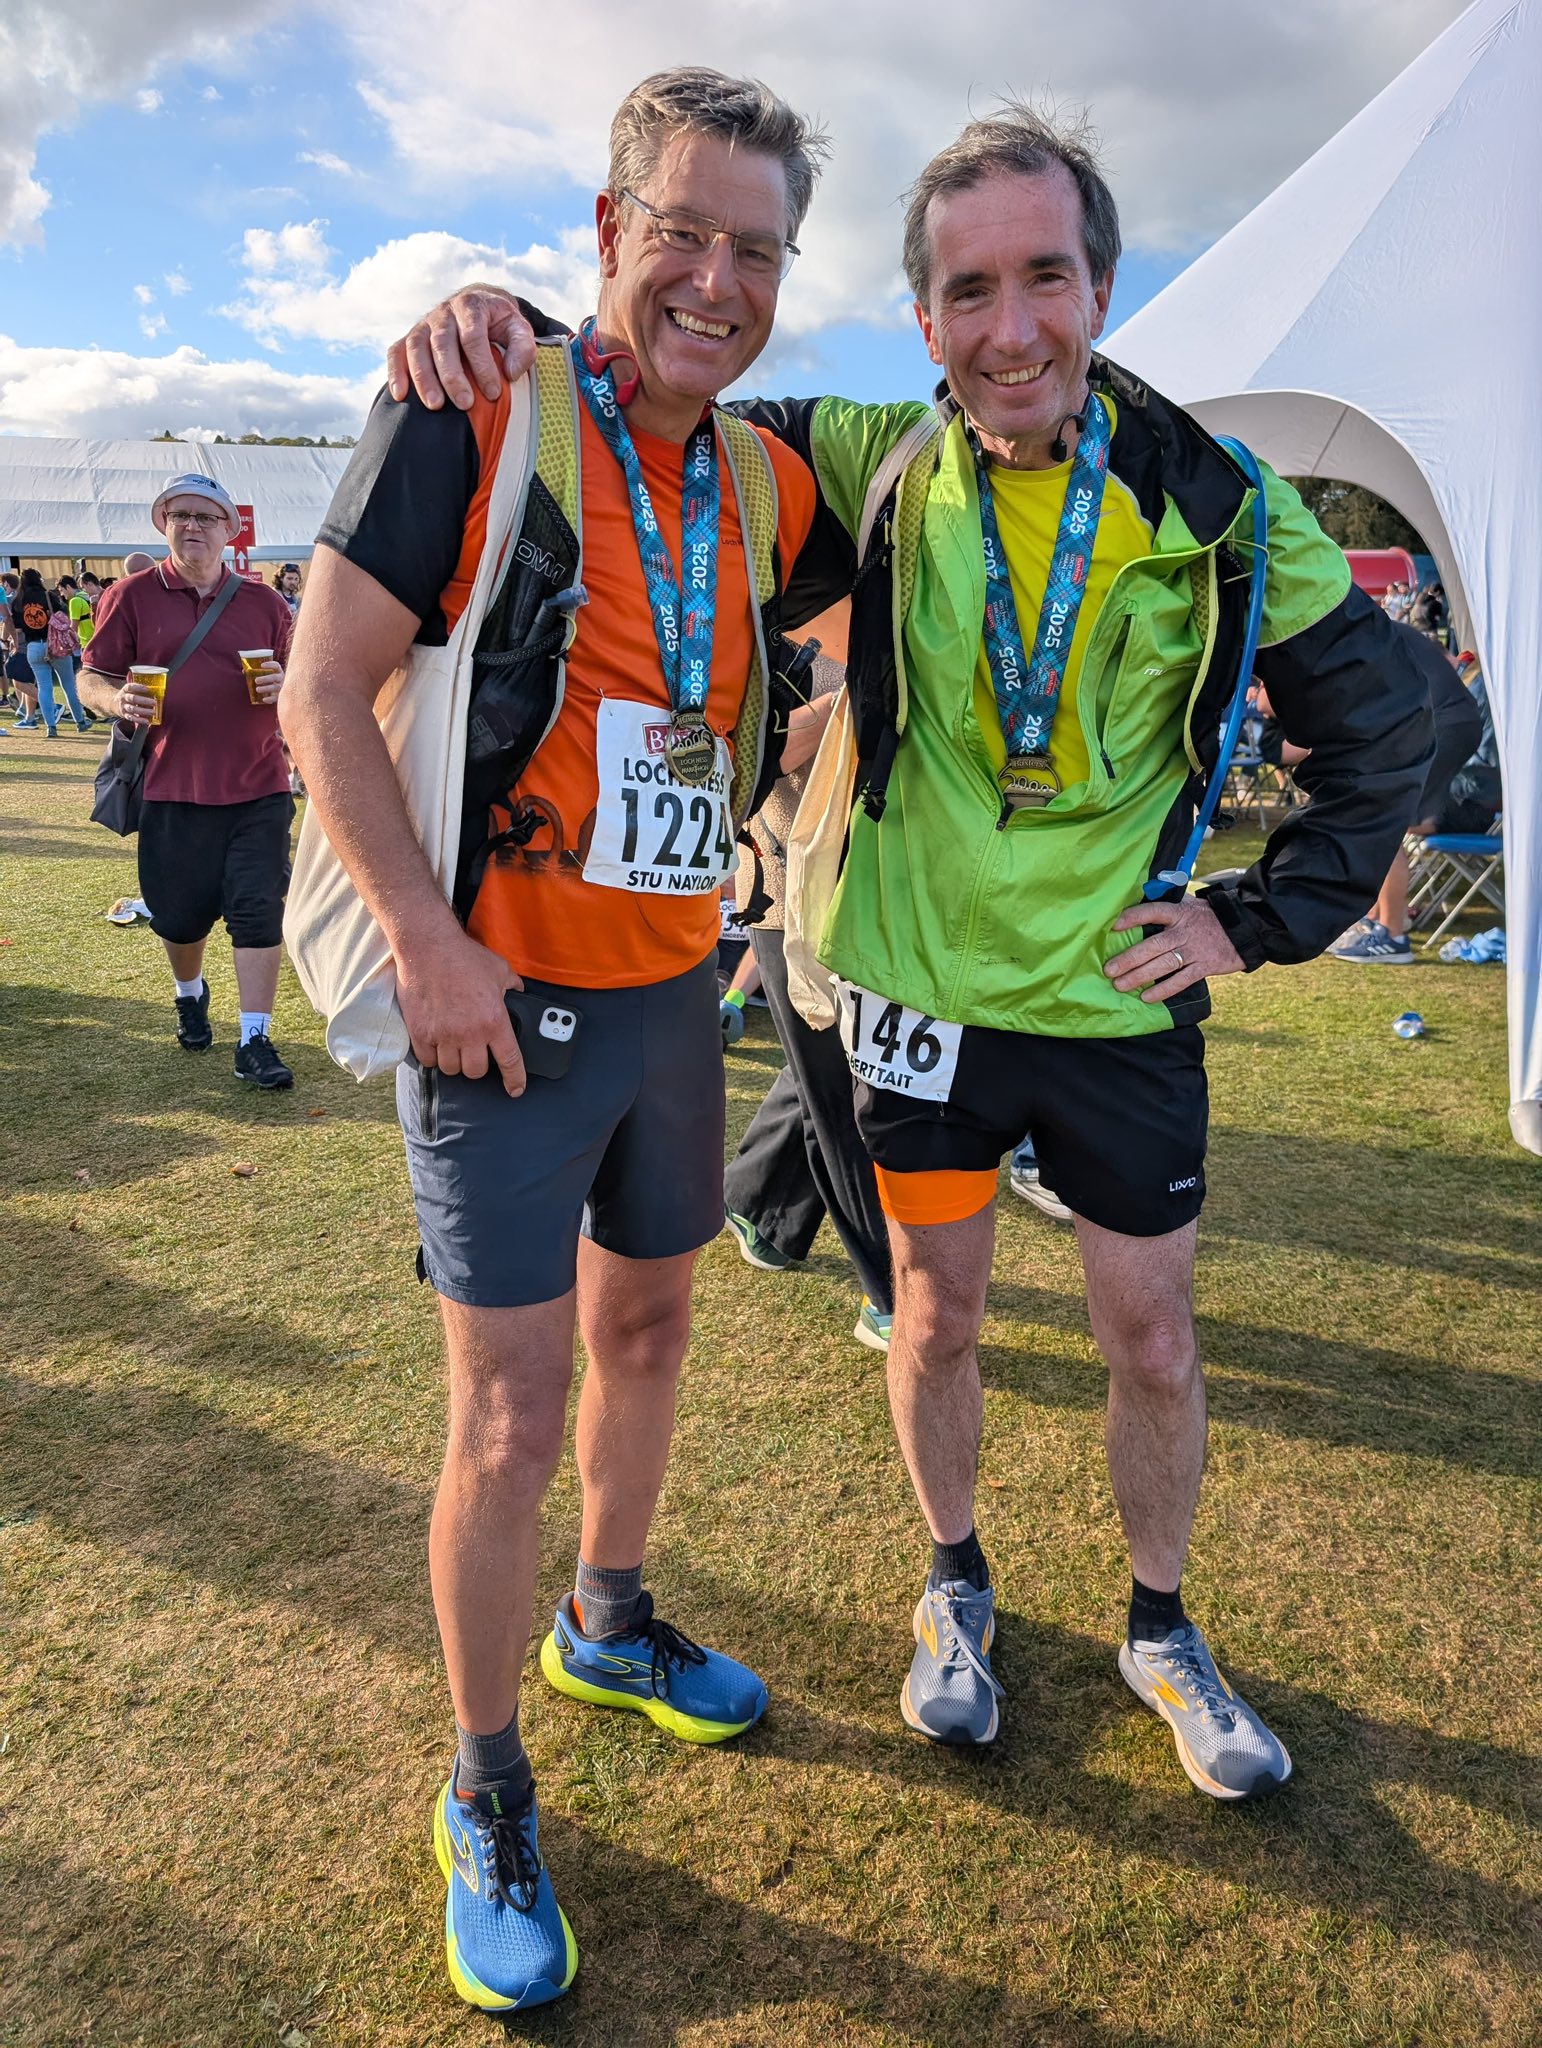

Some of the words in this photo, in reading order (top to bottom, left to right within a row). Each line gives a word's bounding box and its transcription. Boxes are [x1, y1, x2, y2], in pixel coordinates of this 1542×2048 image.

[590, 375, 616, 418] 2025
[695, 434, 711, 478] 2025
[638, 482, 657, 532] 2025
[1069, 487, 1092, 535] 2025
[691, 542, 708, 589] 2025
[660, 604, 680, 652] 2025
[1044, 601, 1068, 648] 2025
[690, 659, 704, 706] 2025
[999, 646, 1021, 692] 2025
[621, 788, 733, 870] 1224
[627, 871, 663, 888] STU
[668, 874, 717, 890] NAYLOR
[849, 990, 942, 1073] 146
[877, 1068, 913, 1089] TAIT
[631, 1663, 652, 1675] BROOK
